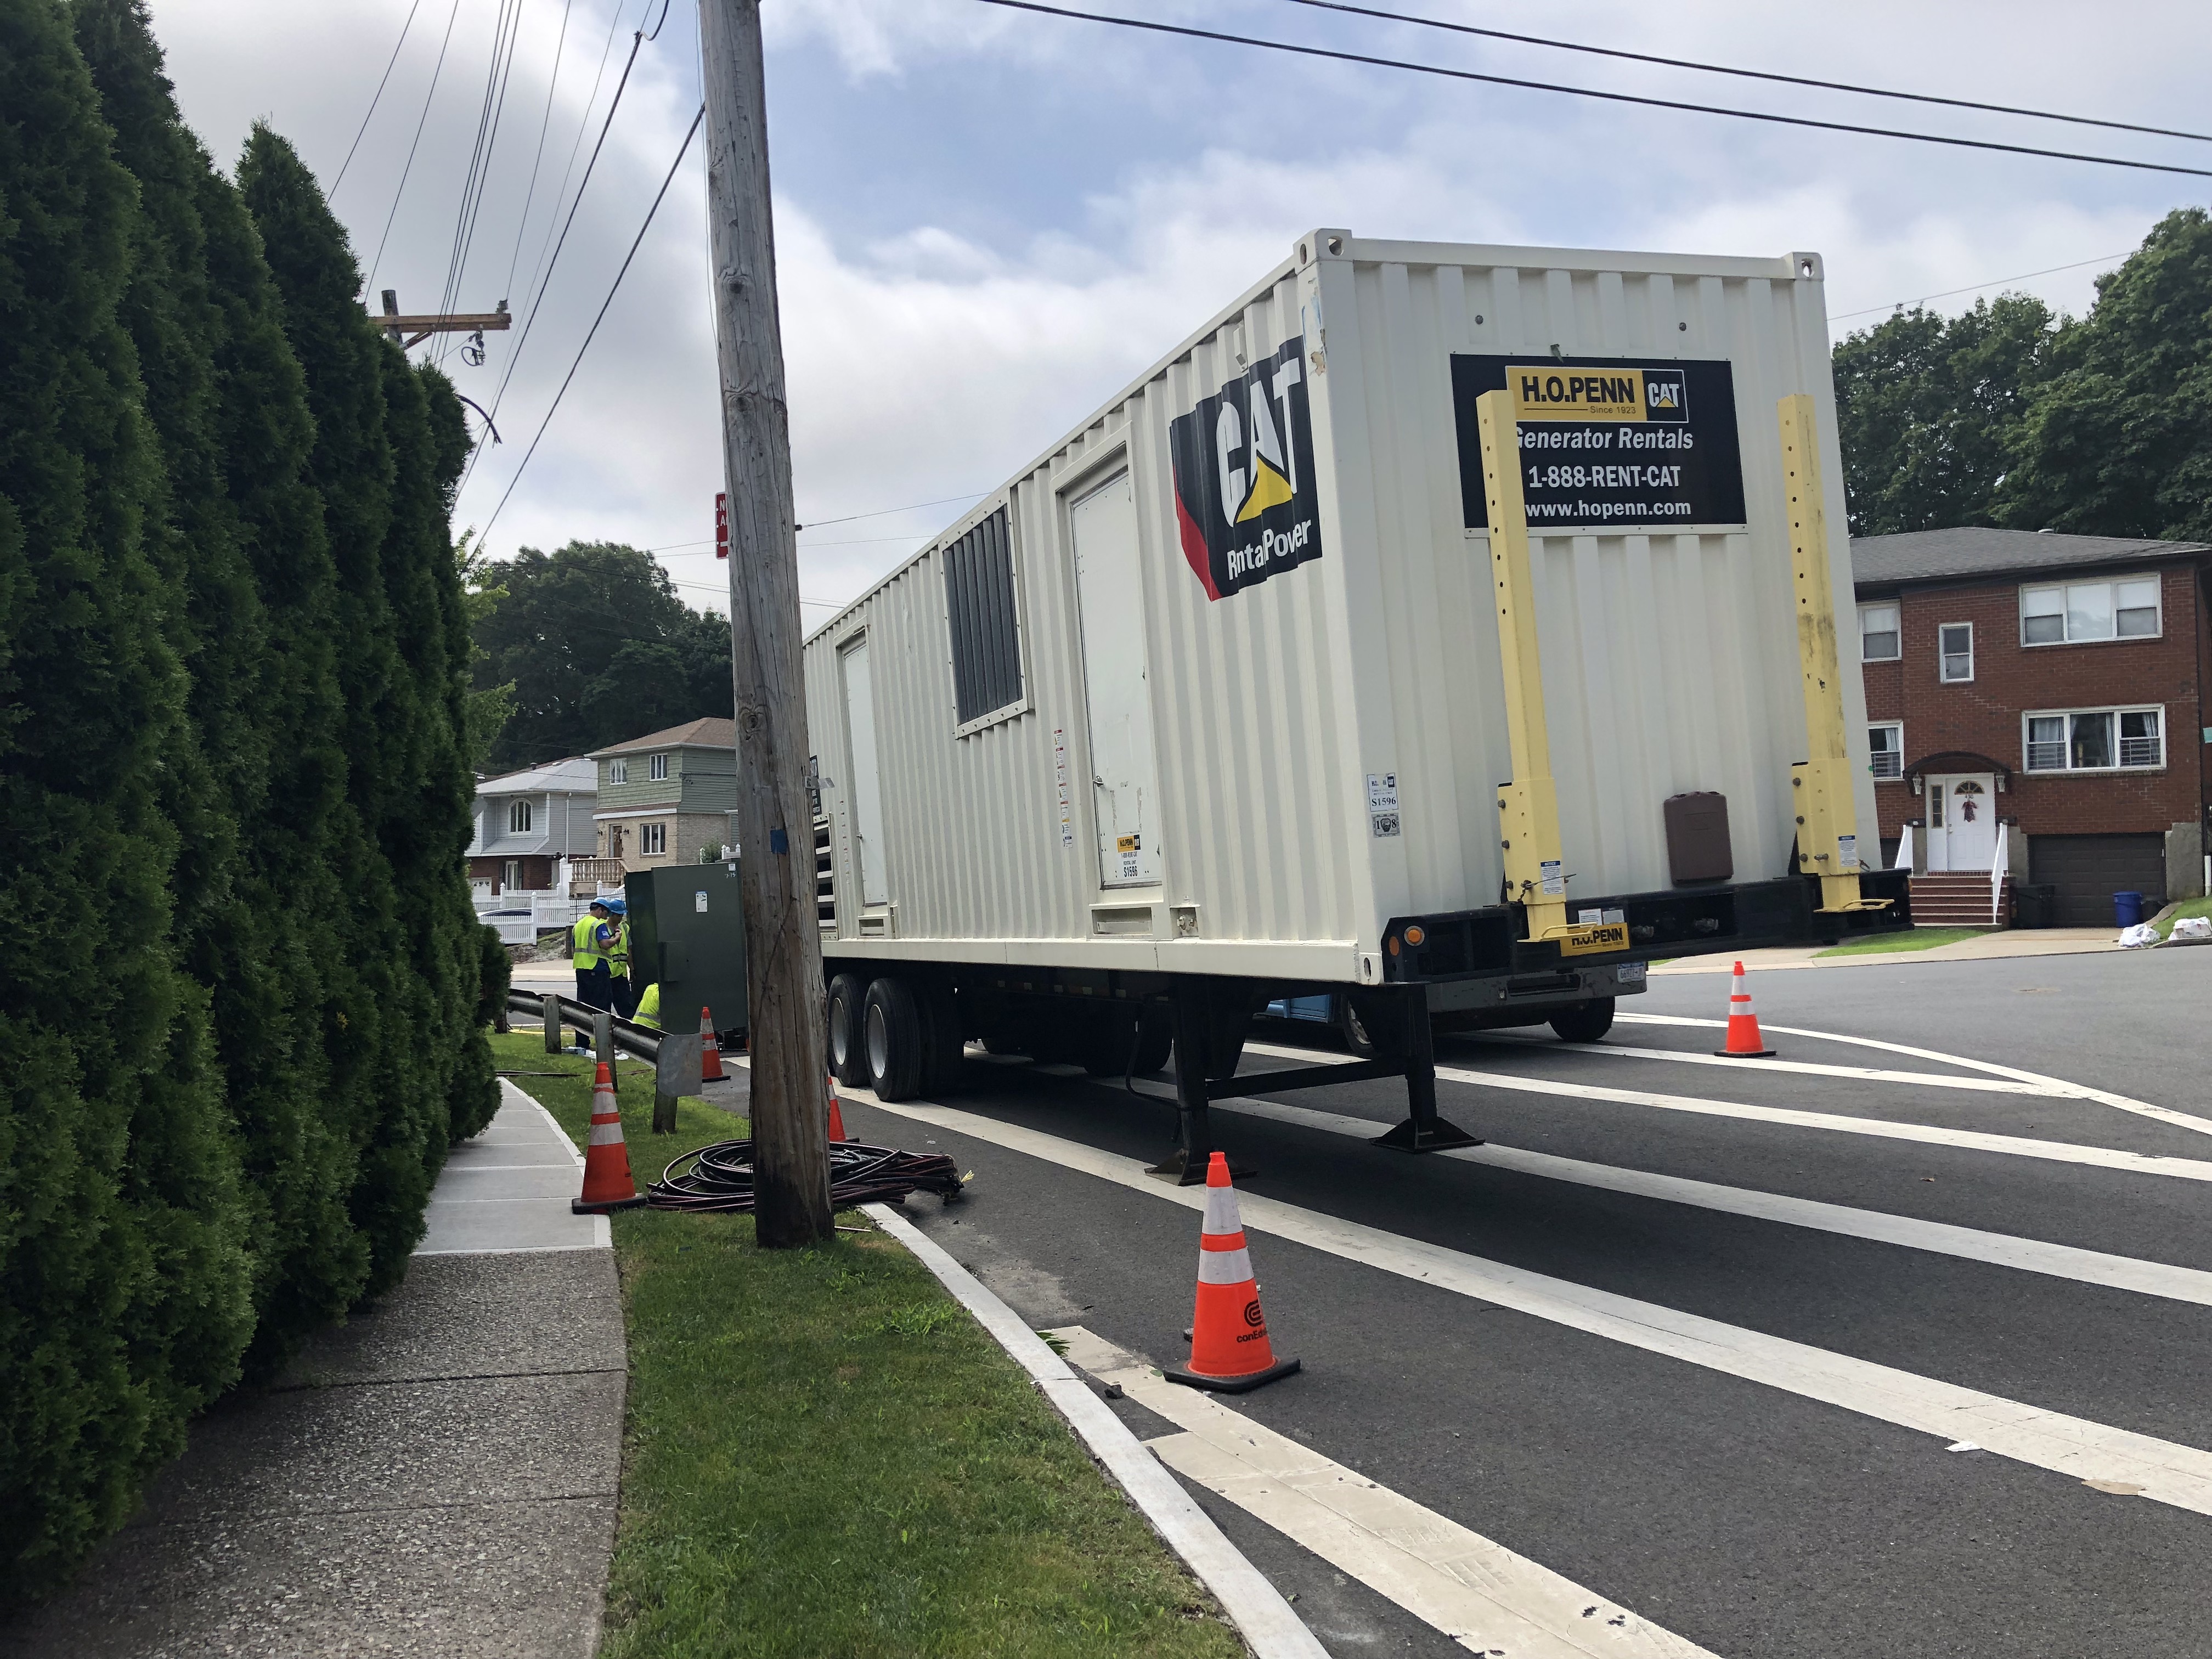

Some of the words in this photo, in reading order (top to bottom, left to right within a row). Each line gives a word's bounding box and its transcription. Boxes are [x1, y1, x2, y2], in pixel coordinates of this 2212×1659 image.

[1521, 376, 1635, 403] H.O.PENN
[1647, 382, 1679, 408] CAT
[1590, 405, 1613, 414] Since
[1617, 406, 1636, 414] 1923
[1216, 357, 1301, 528] CAT
[1618, 427, 1693, 449] Rentals
[1528, 465, 1681, 488] 1-888-RENT-CAT
[1525, 499, 1691, 519] www.hopenn.com
[1372, 797, 1396, 806] S1596
[1124, 866, 1138, 877] S1596
